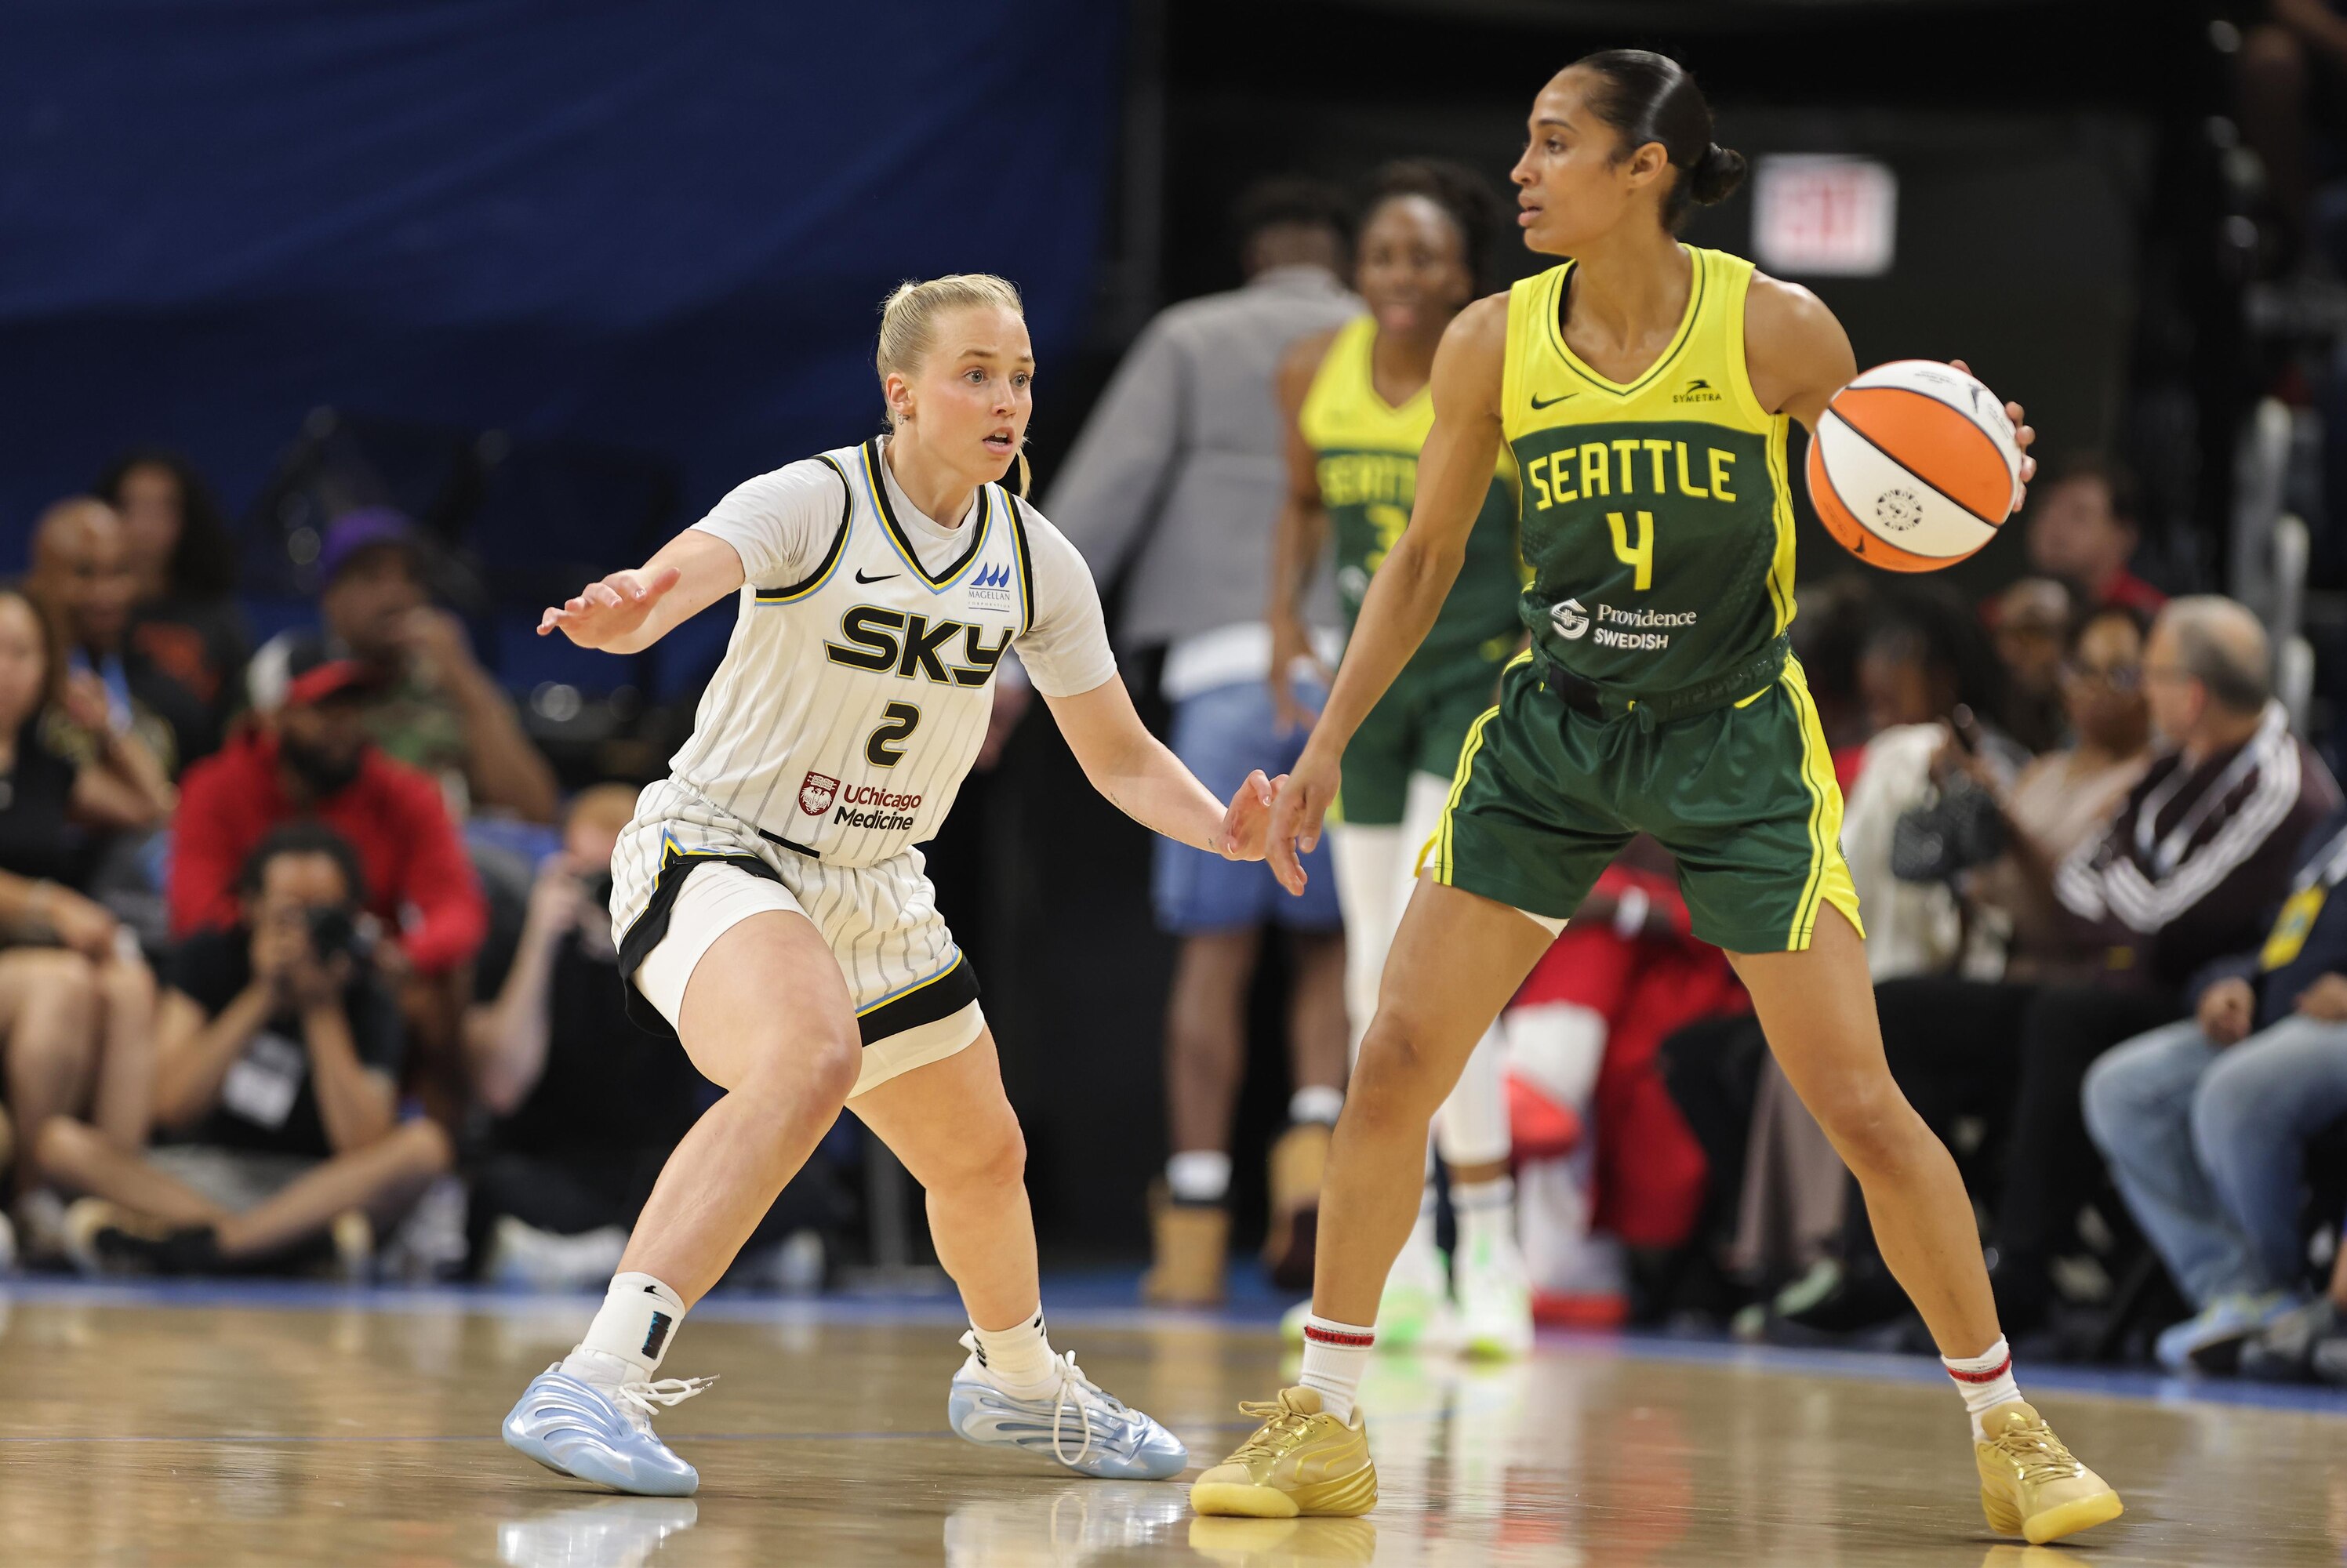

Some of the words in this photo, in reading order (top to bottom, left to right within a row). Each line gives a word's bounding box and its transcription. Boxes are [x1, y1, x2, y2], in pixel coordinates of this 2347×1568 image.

[1673, 393, 1723, 404] SYMETRA
[1528, 439, 1738, 510] SEATTLE
[1606, 510, 1655, 591] 4
[968, 590, 1011, 601] MAGELLAN
[1597, 603, 1698, 627] Providence
[823, 603, 1016, 689] SKY
[1593, 627, 1670, 651] SWEDISH
[863, 699, 922, 769] 2
[844, 784, 922, 811] UChicago
[834, 806, 914, 831] Medicine
